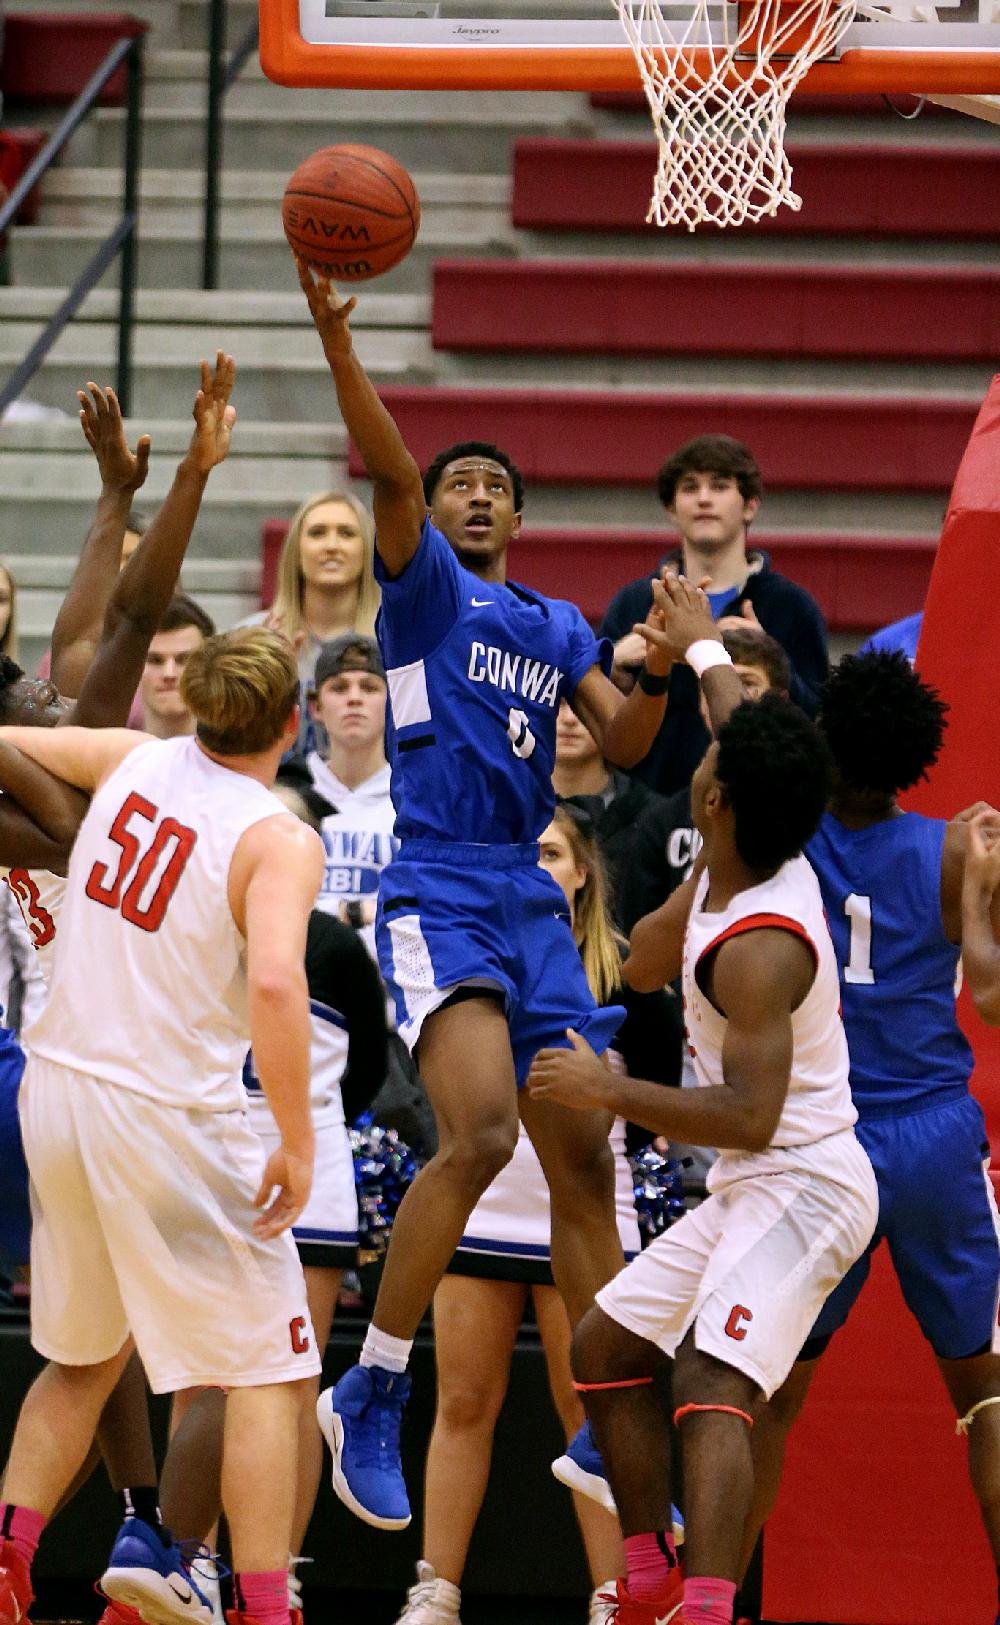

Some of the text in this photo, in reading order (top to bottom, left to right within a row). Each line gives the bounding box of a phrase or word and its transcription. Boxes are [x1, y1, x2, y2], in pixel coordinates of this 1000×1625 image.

[289, 209, 369, 241] WAVE
[467, 641, 565, 708] CONWA
[507, 707, 536, 760] 0
[85, 790, 198, 932] 50
[844, 893, 875, 985] 1
[290, 1316, 310, 1354] C
[725, 1304, 753, 1341] C
